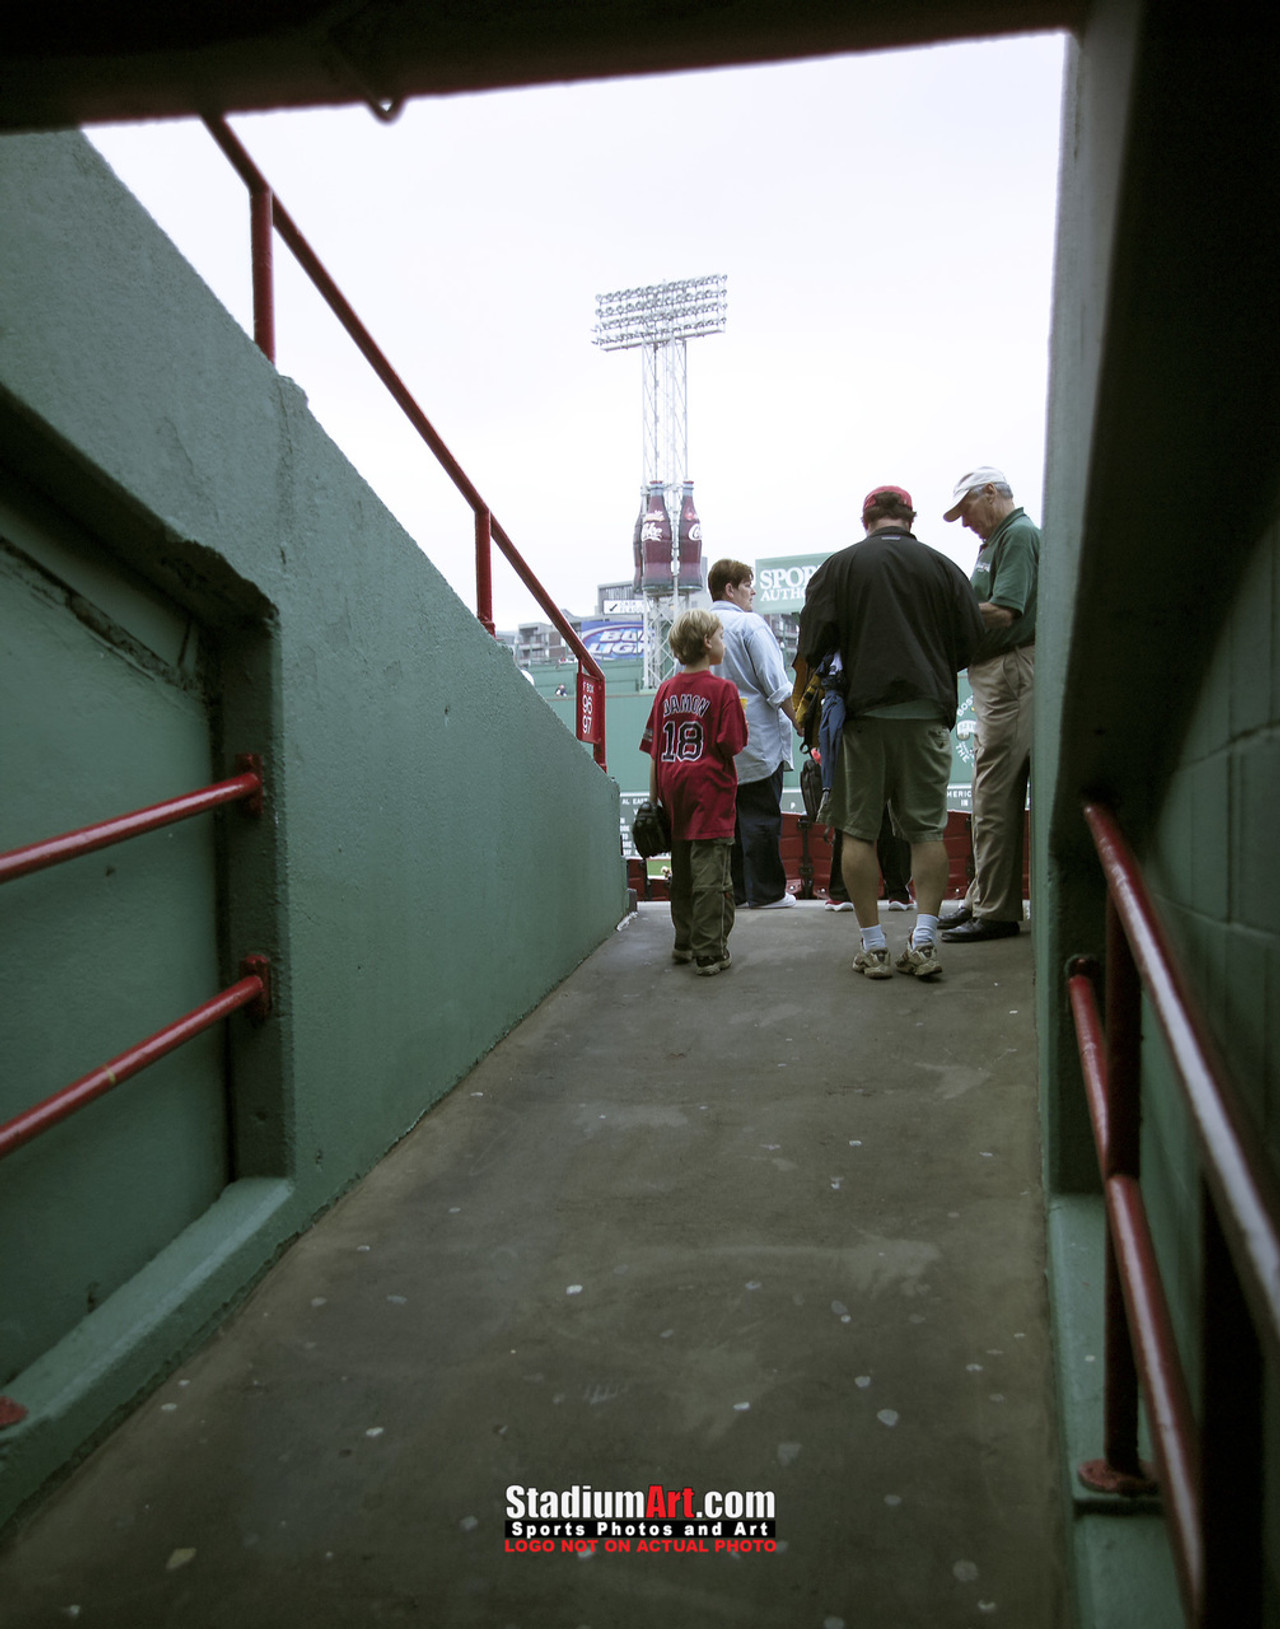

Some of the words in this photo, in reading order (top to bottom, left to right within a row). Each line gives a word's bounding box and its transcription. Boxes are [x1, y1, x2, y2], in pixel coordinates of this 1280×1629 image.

[760, 565, 821, 589] SPOR
[600, 630, 654, 642] BU
[588, 642, 652, 655] LIG
[582, 694, 593, 715] 96
[582, 715, 592, 734] 97
[661, 721, 703, 762] 18
